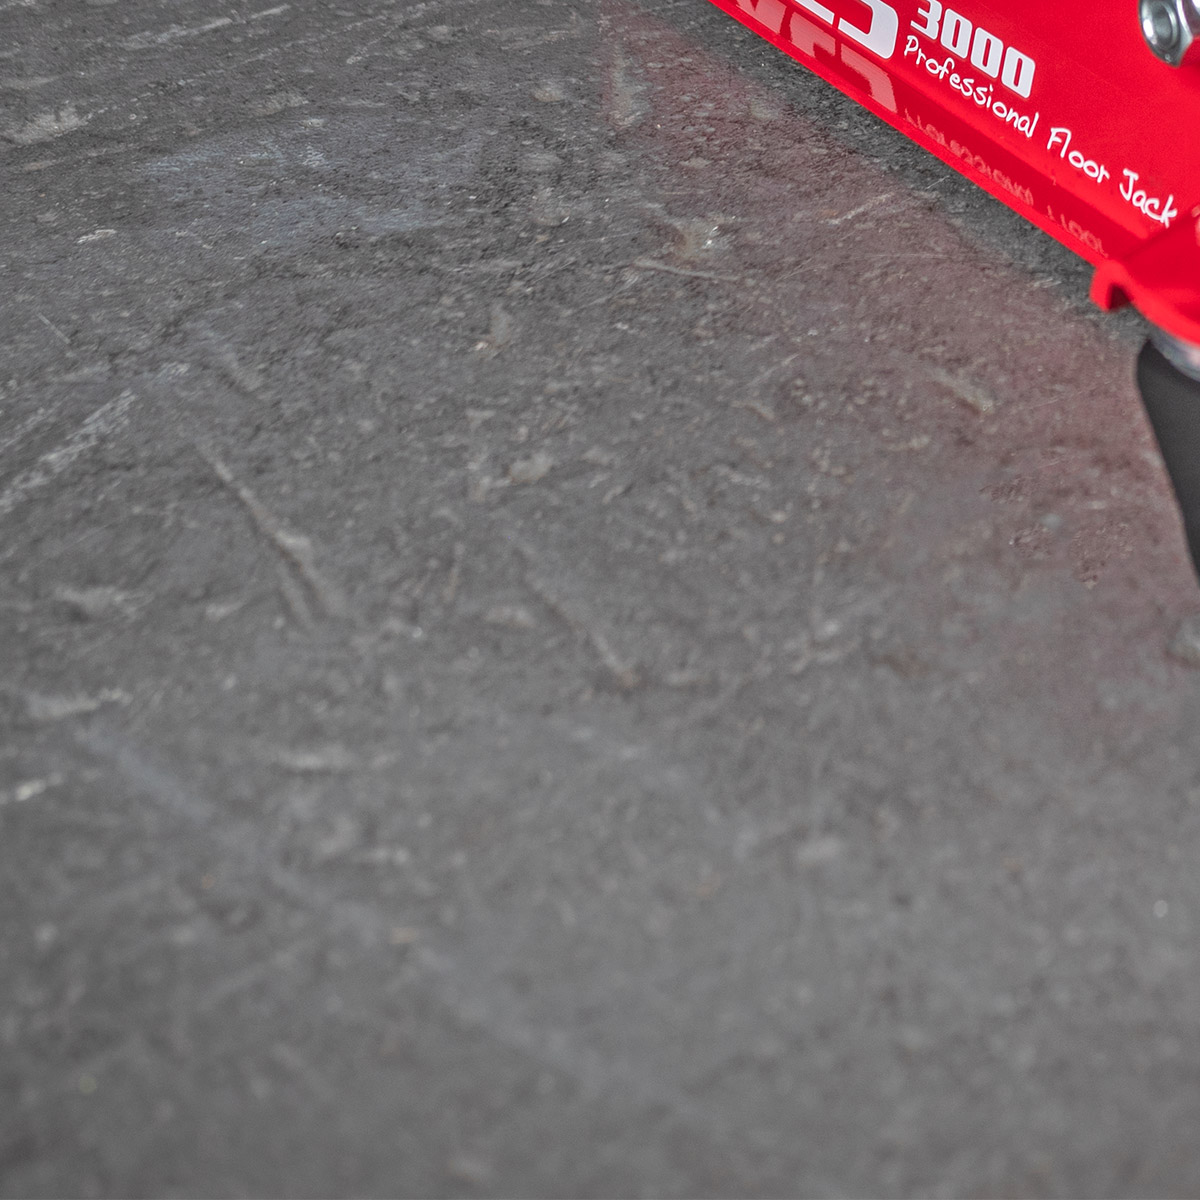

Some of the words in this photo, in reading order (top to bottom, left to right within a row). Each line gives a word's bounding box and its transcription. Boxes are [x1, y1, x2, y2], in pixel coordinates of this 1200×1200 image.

[904, 34, 1039, 138] Professional
[1047, 127, 1110, 184] Floor
[1119, 167, 1178, 227] Jack
